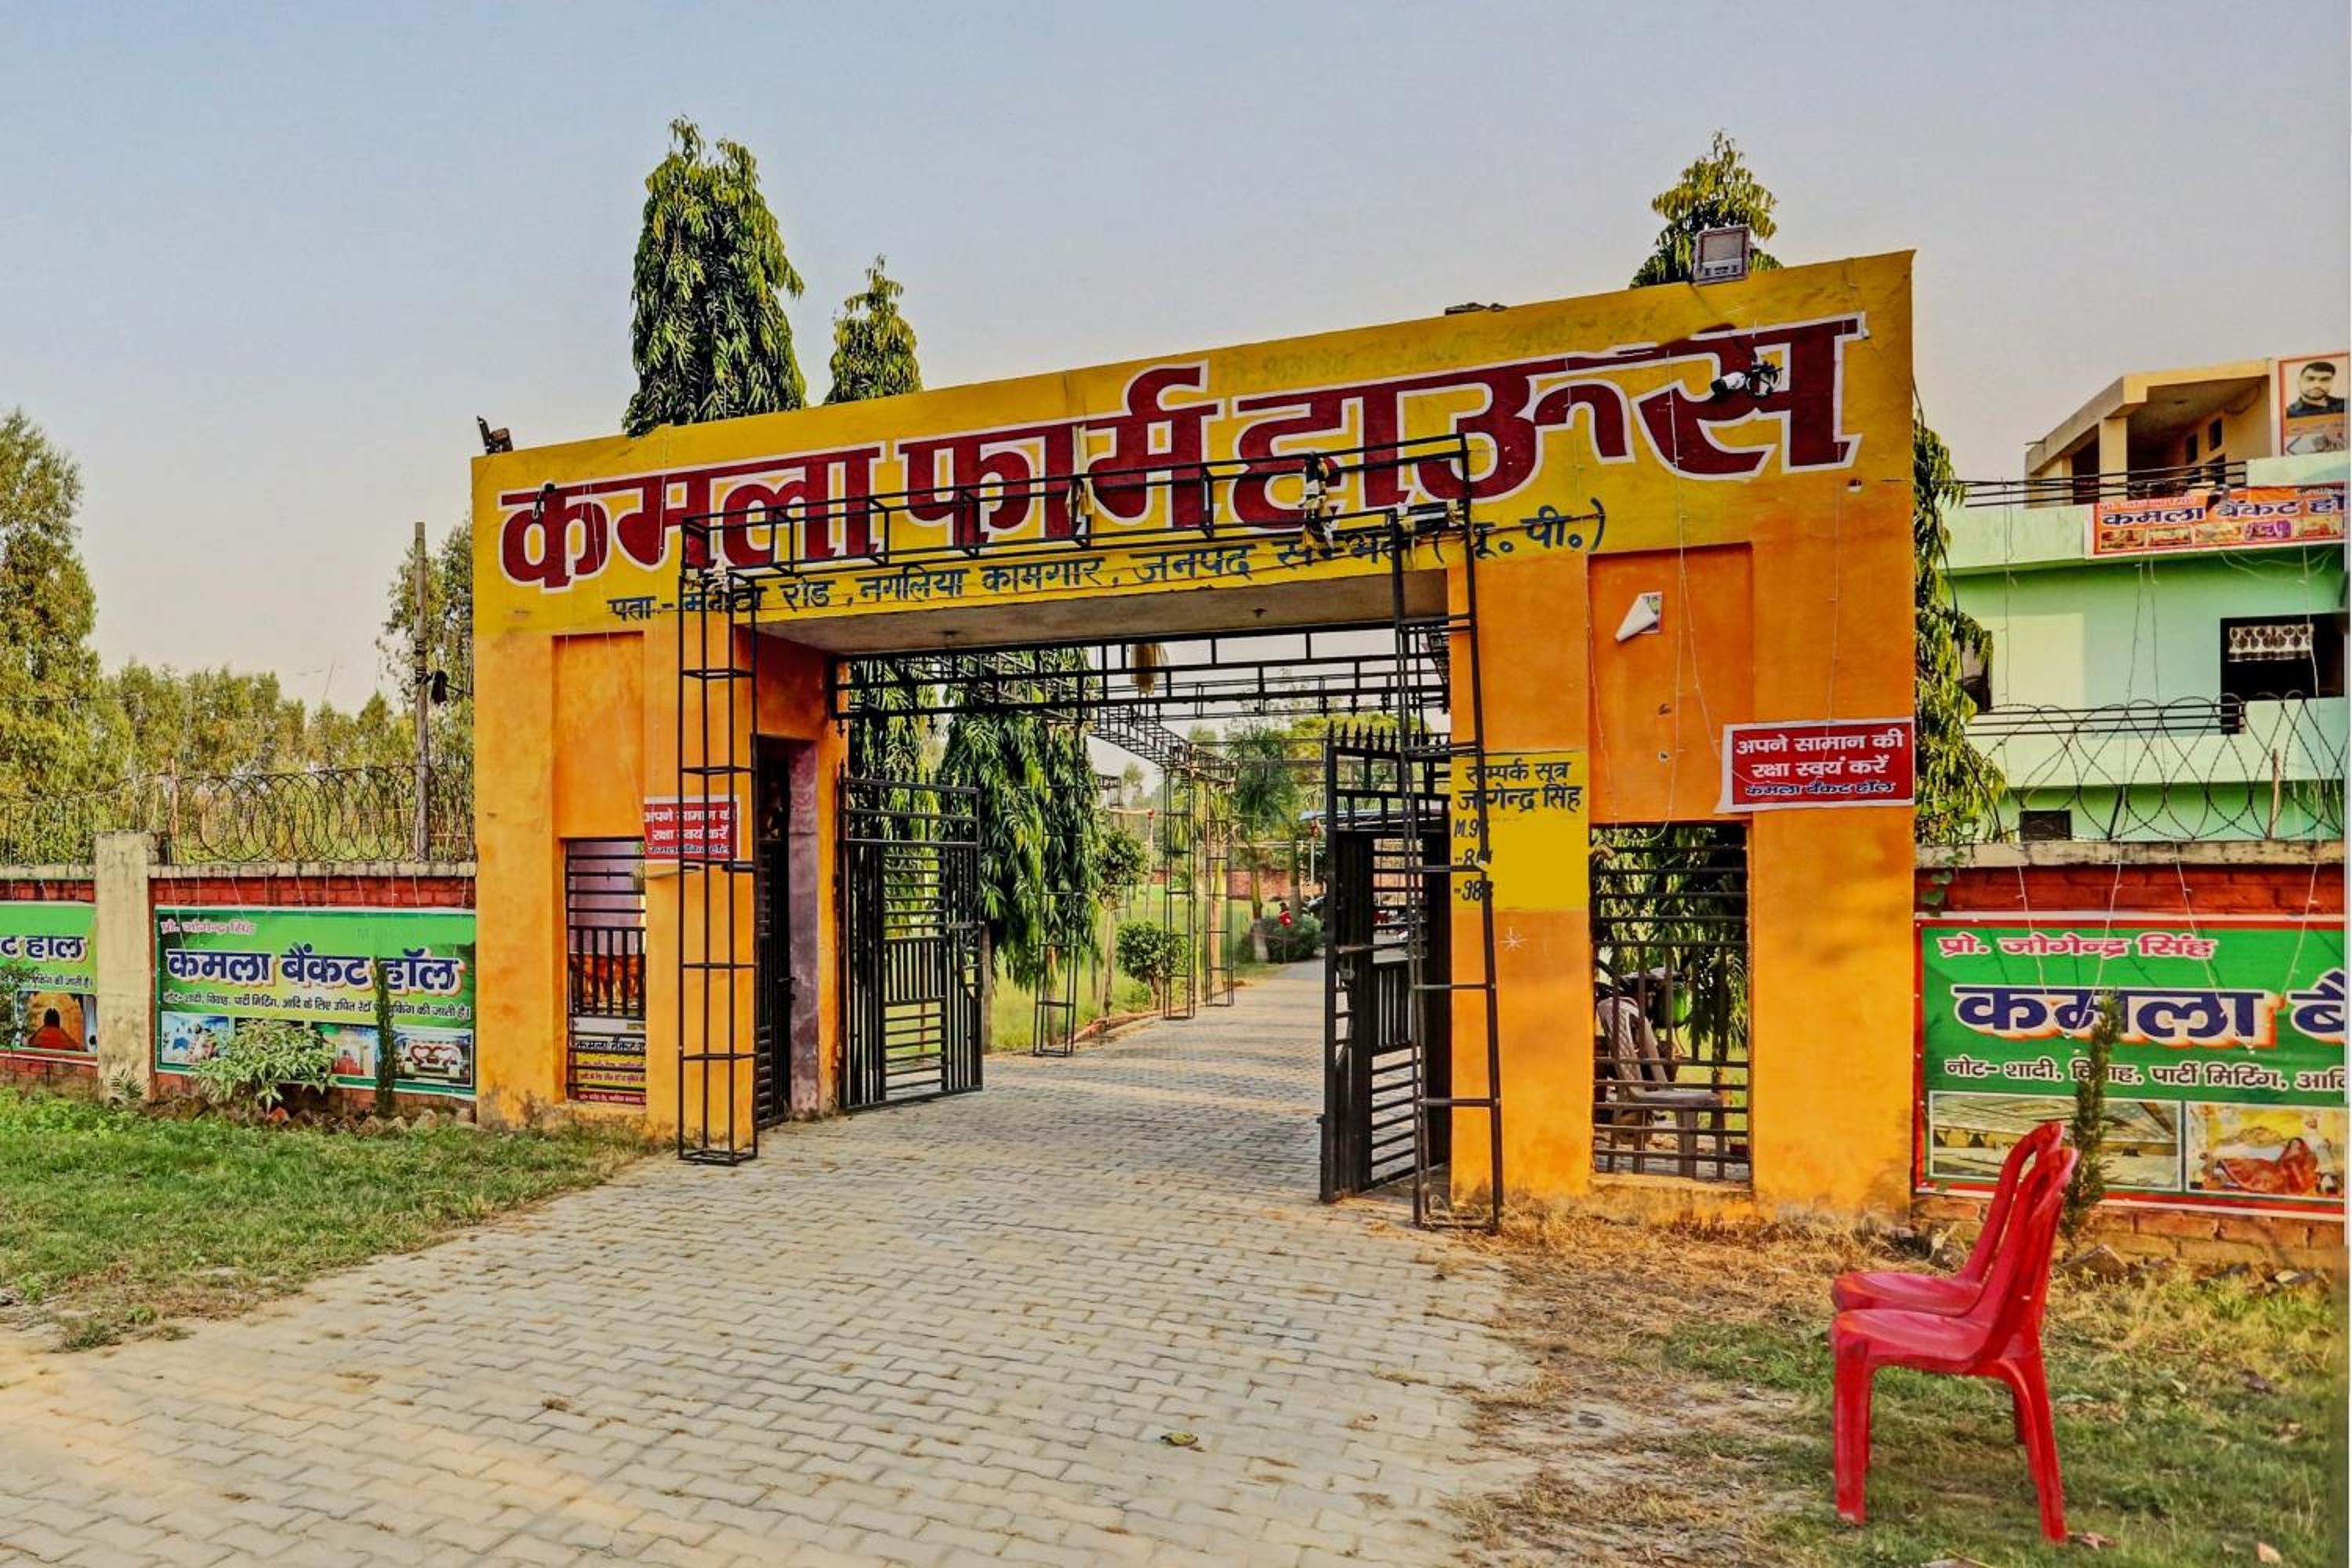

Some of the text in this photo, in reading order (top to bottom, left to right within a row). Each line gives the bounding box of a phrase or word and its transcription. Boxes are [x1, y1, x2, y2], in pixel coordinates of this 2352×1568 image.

[499, 441, 885, 591] कमला
[897, 359, 1225, 550] फार्म
[855, 564, 971, 601] नगलिया
[1130, 543, 1257, 582] जनपद
[1736, 728, 1904, 754] अपने सामान की
[1534, 762, 1571, 784] सूत्र
[1751, 755, 1890, 778] रक्षा स्वयं करें
[1542, 782, 1583, 812] सिंह
[1939, 933, 2218, 959] प्रो. जोगेन्द्र सिंह
[168, 942, 459, 989] कमला बैंकट हॉल
[1954, 986, 2264, 1037] कमला
[2071, 1059, 2144, 1083] विाह,
